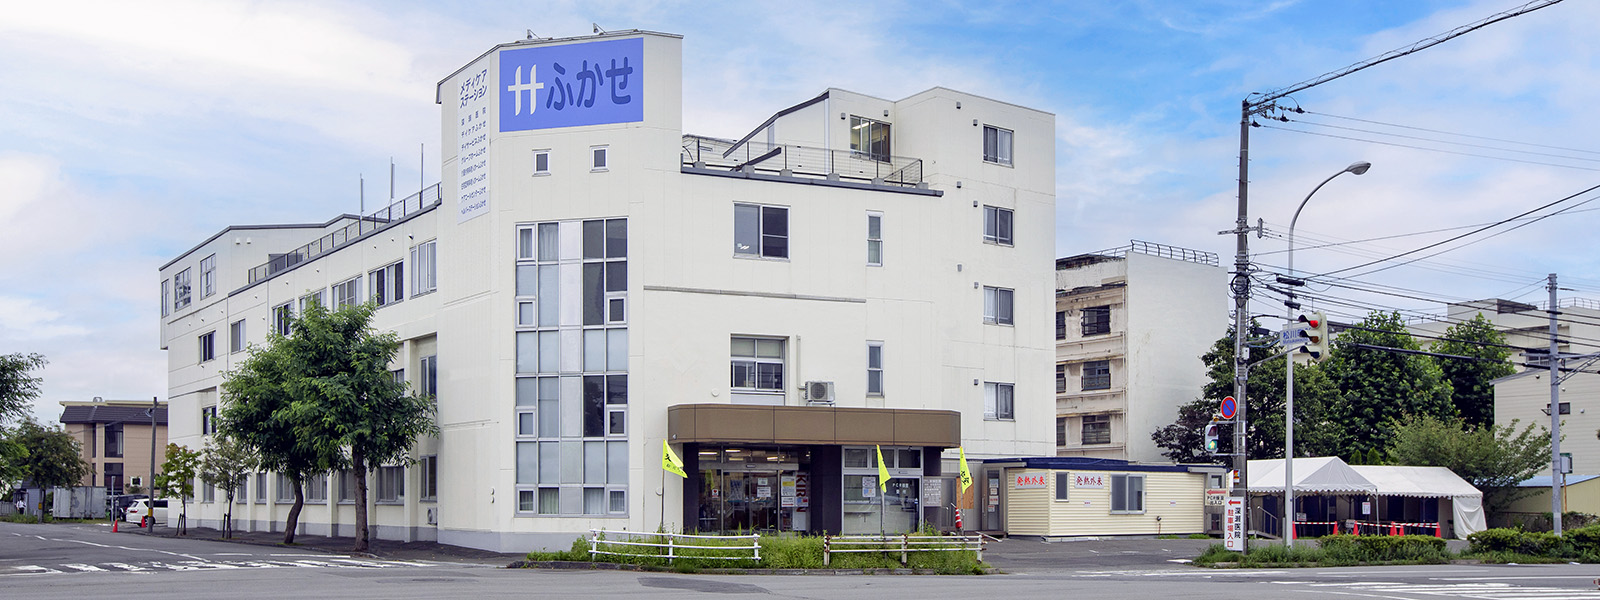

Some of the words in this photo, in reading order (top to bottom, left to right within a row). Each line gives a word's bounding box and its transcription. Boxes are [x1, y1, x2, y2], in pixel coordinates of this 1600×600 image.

[460, 69, 487, 95] メディケア
[546, 56, 633, 111] ふかせ
[460, 85, 487, 108] ステーション
[1016, 475, 1045, 486] 発熱外来
[1076, 475, 1103, 486] 発熱外来
[796, 475, 807, 512] KIRN
